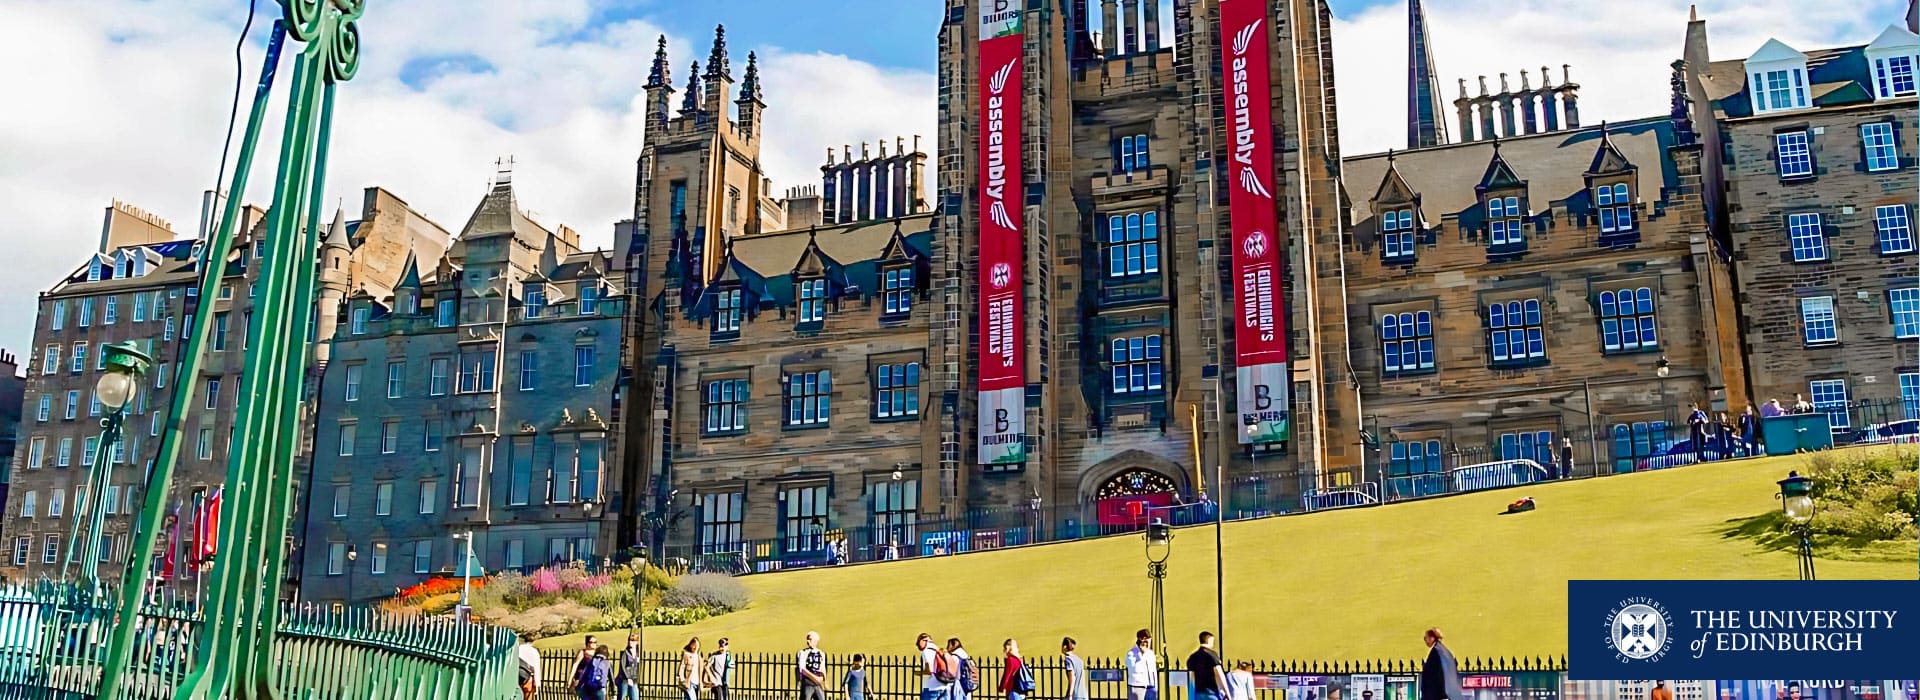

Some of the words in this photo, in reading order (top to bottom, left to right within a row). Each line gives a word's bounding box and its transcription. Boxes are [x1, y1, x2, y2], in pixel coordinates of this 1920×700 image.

[1233, 57, 1256, 165] assembly
[987, 96, 1006, 200] assembly
[989, 301, 1001, 354] FESTIVALS
[1243, 272, 1258, 328] FESTIVALS
[1257, 269, 1274, 342] EDINBURGH'S
[995, 408, 1009, 433] B
[1254, 385, 1271, 410] B
